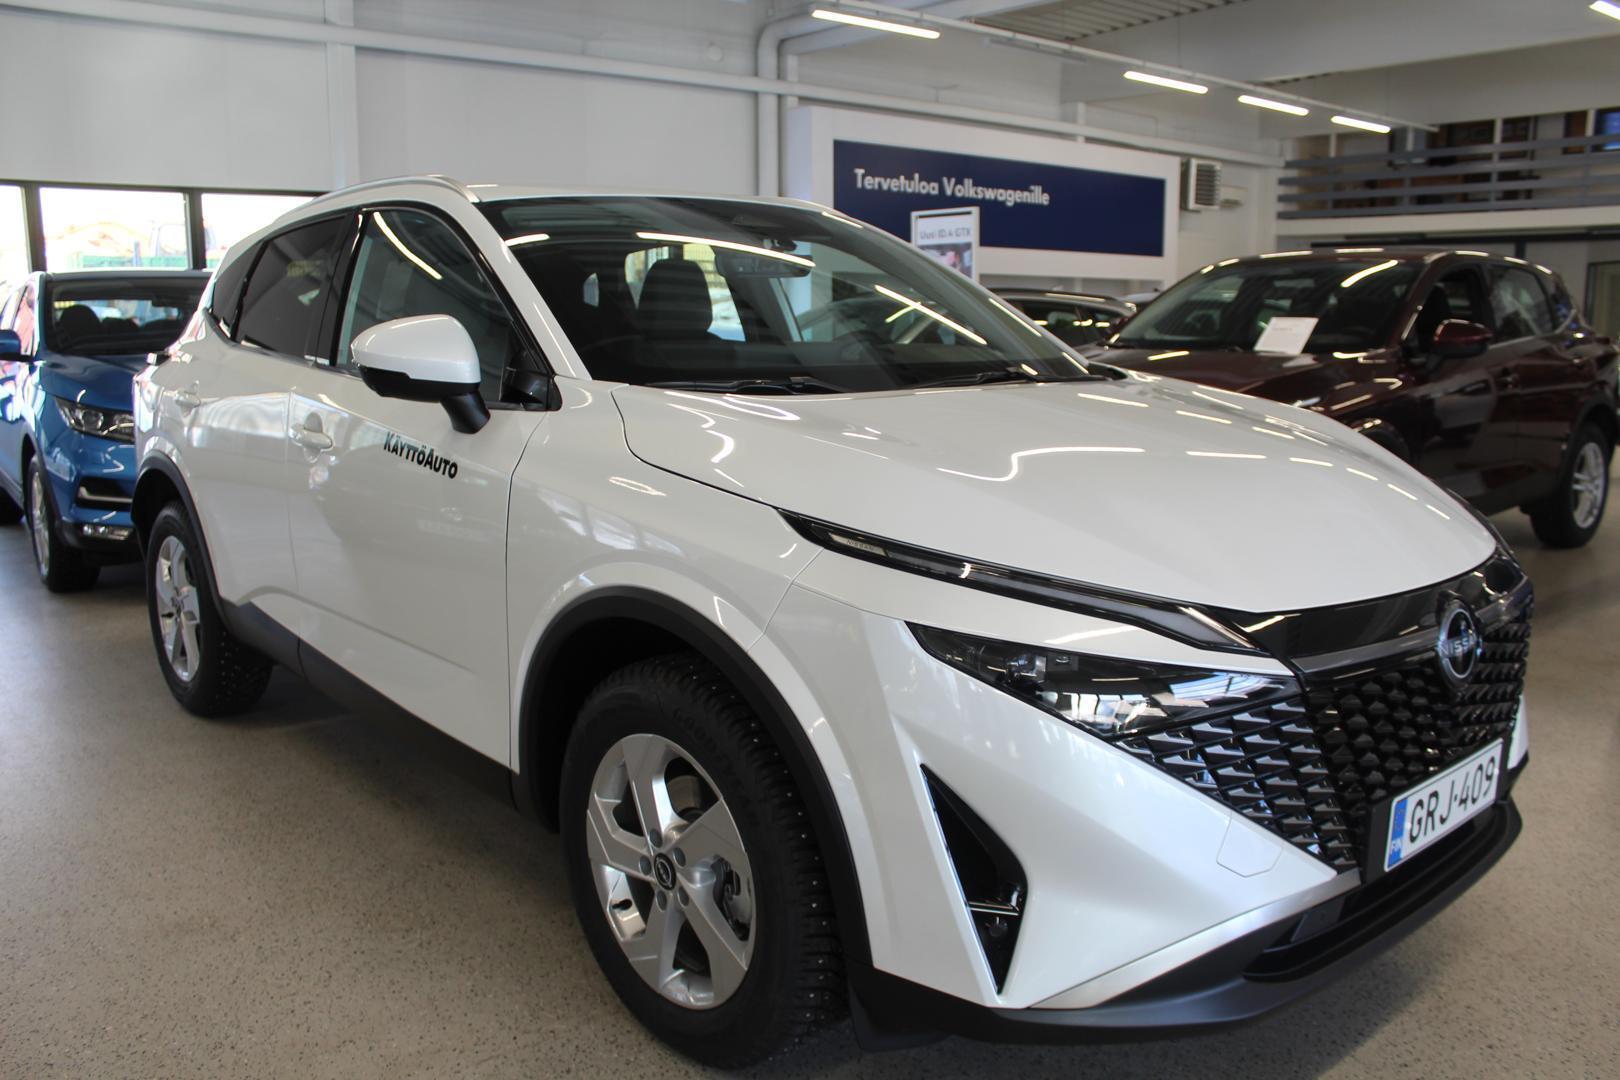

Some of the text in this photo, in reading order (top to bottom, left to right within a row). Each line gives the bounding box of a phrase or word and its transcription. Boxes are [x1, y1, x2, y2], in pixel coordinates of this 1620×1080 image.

[854, 168, 1050, 206] Tervetuloa Volkswagenille
[1439, 635, 1476, 656] NISSA
[1410, 756, 1496, 843] GRJ-409
